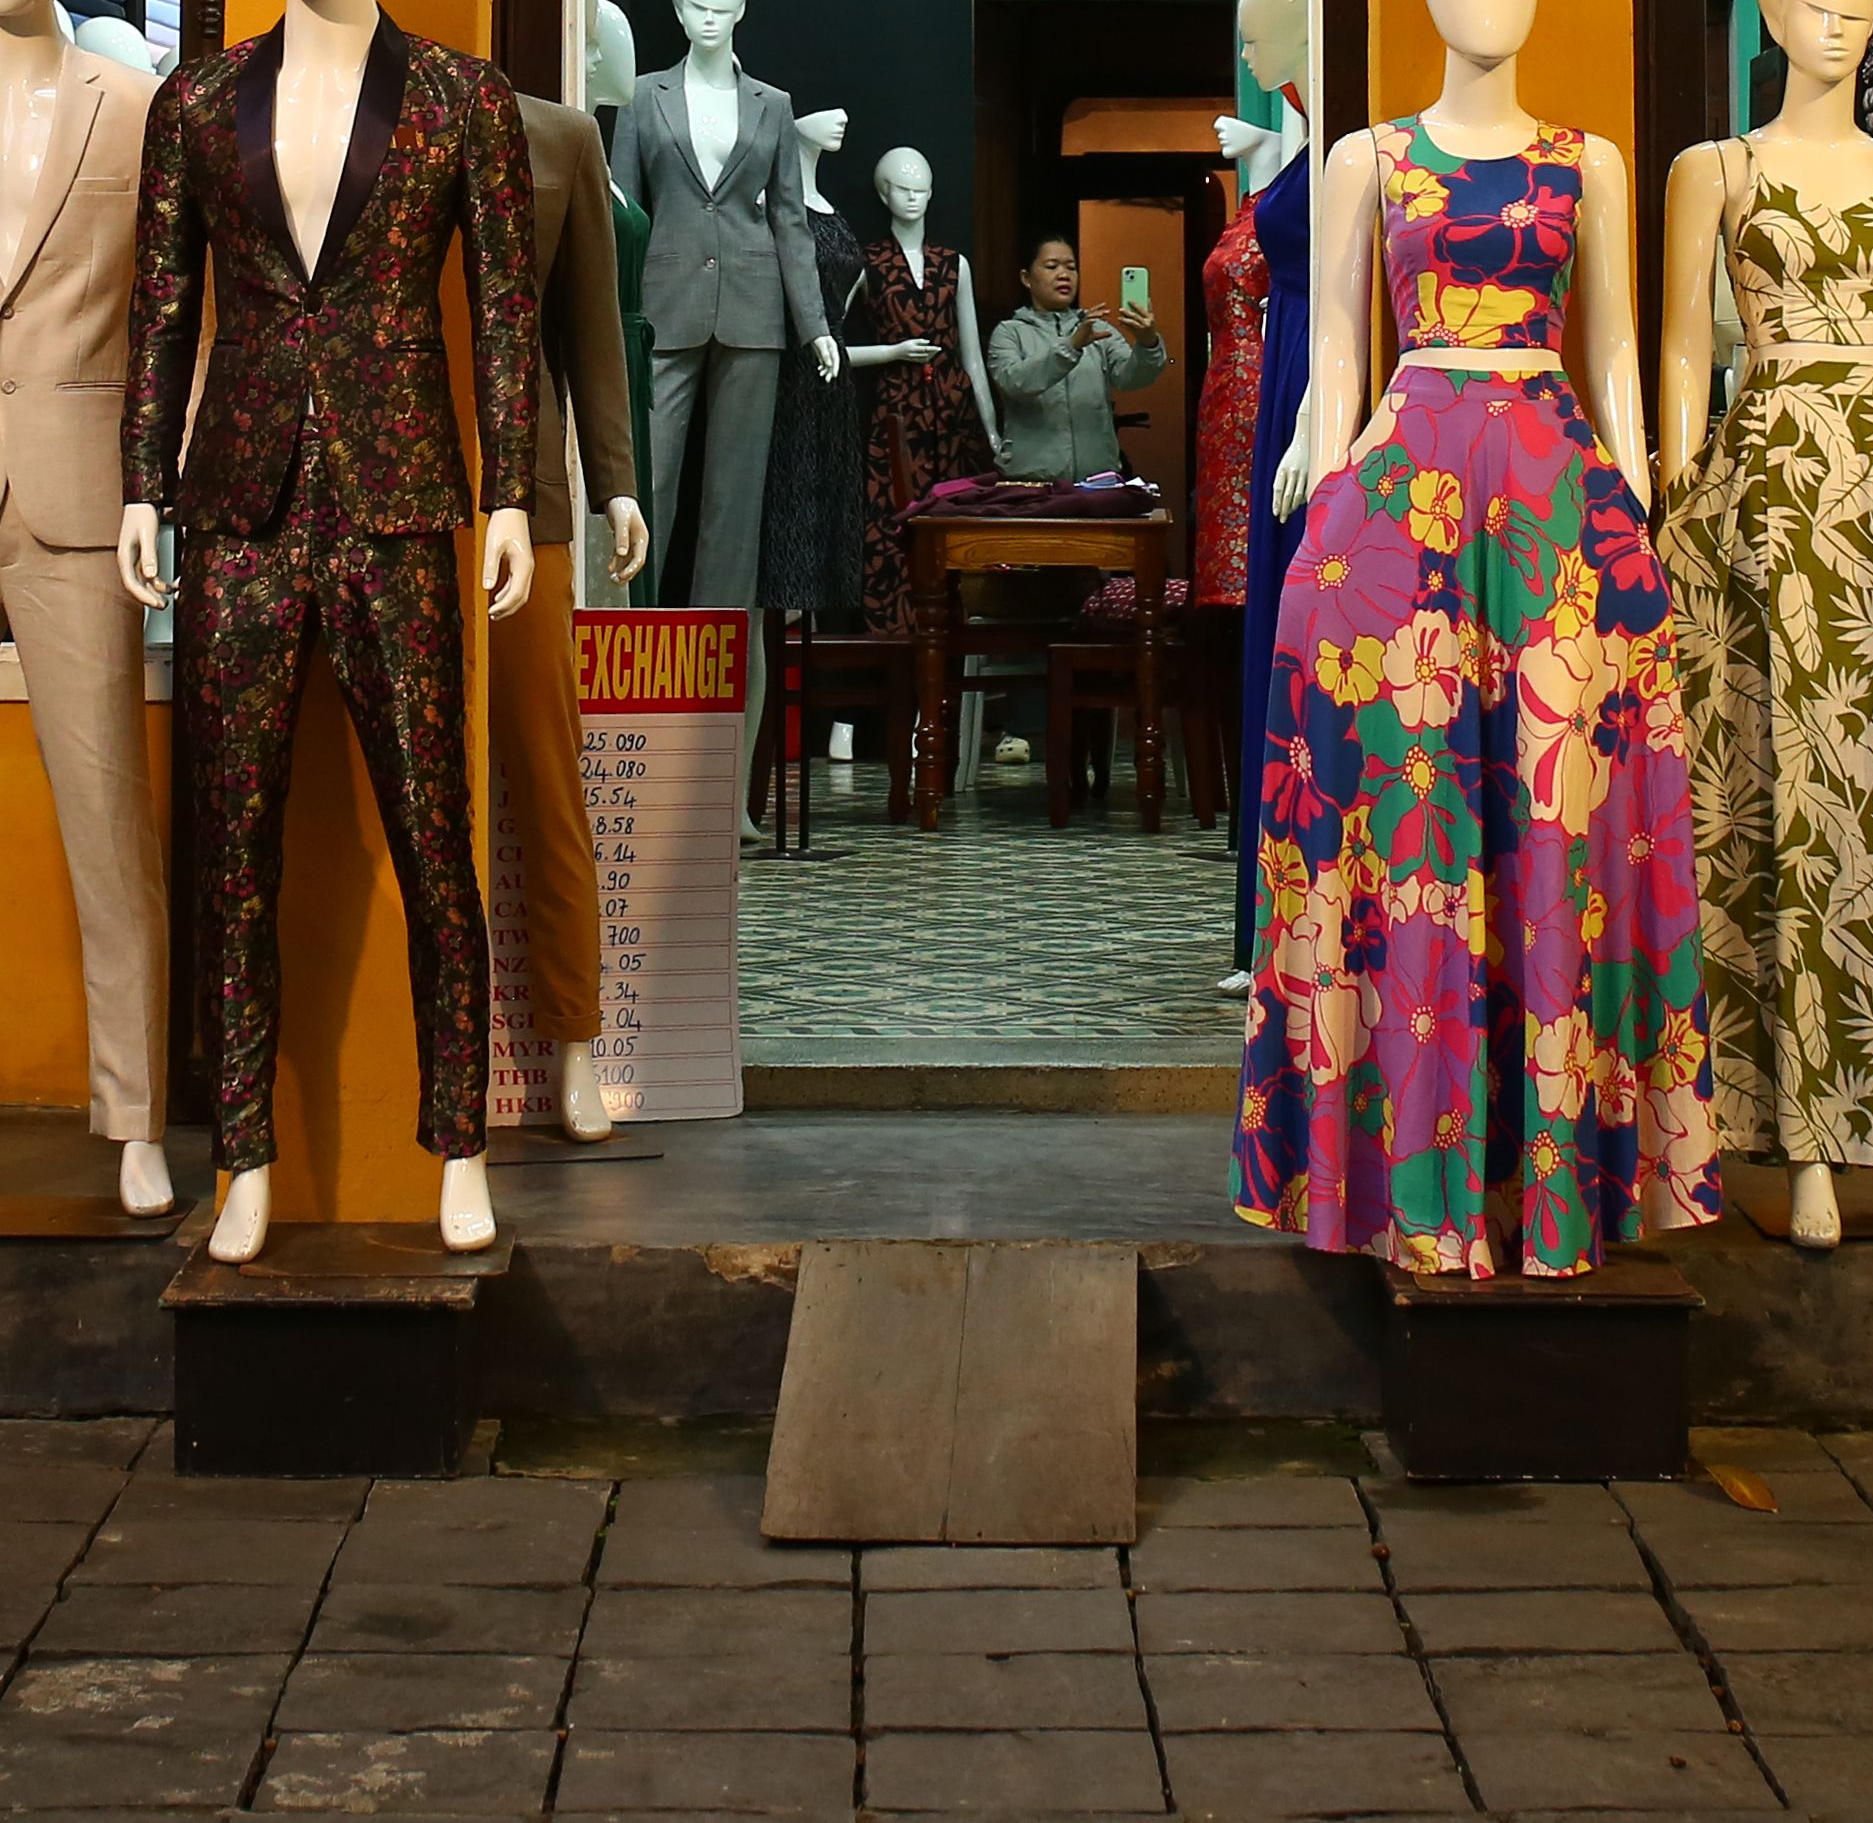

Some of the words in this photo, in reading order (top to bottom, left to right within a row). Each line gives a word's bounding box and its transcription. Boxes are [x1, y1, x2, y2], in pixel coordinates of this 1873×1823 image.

[574, 624, 736, 700] EXCHANGE
[592, 816, 635, 835] 8.58
[493, 1041, 554, 1058] MYR
[493, 1069, 548, 1086] THB
[495, 1097, 553, 1114] HKB
